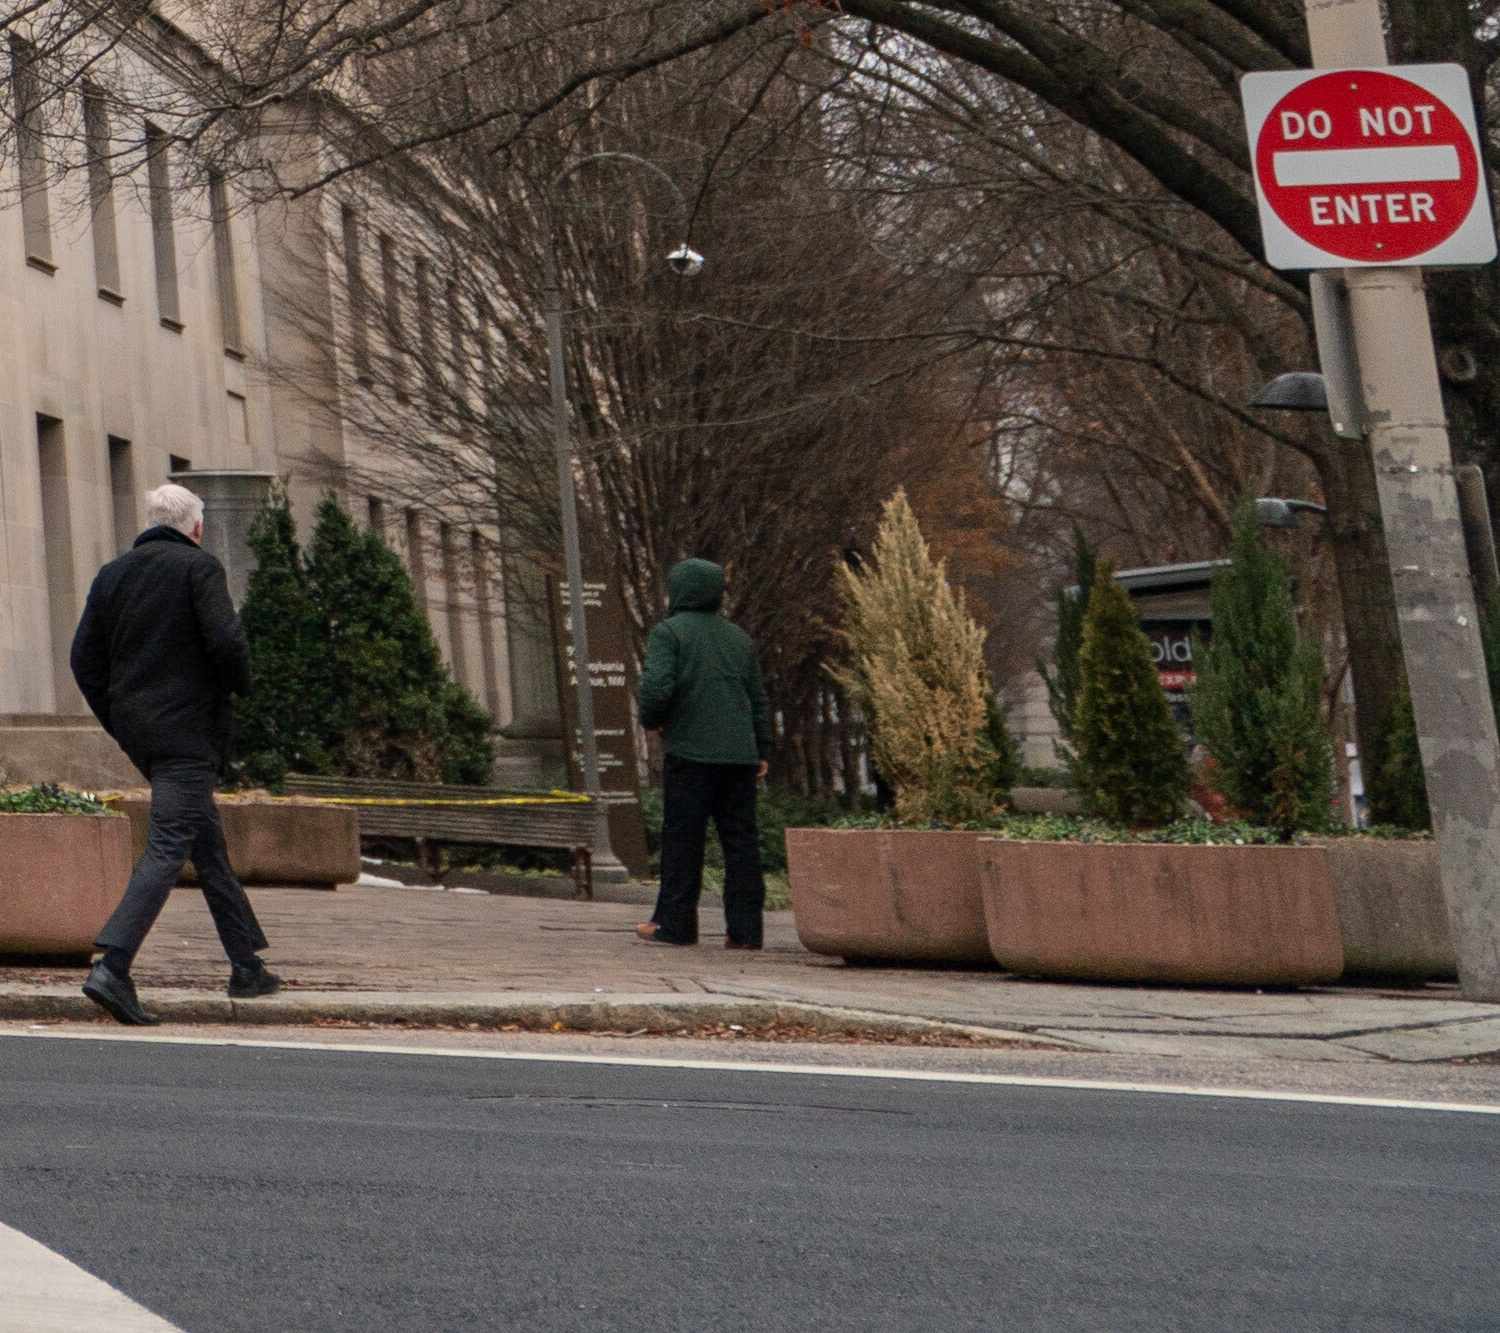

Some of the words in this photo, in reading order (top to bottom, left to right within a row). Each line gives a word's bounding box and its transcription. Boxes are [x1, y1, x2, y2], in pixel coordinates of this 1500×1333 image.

[1280, 109, 1332, 140] DO
[1359, 105, 1436, 137] NOT
[1309, 193, 1437, 226] ENTER
